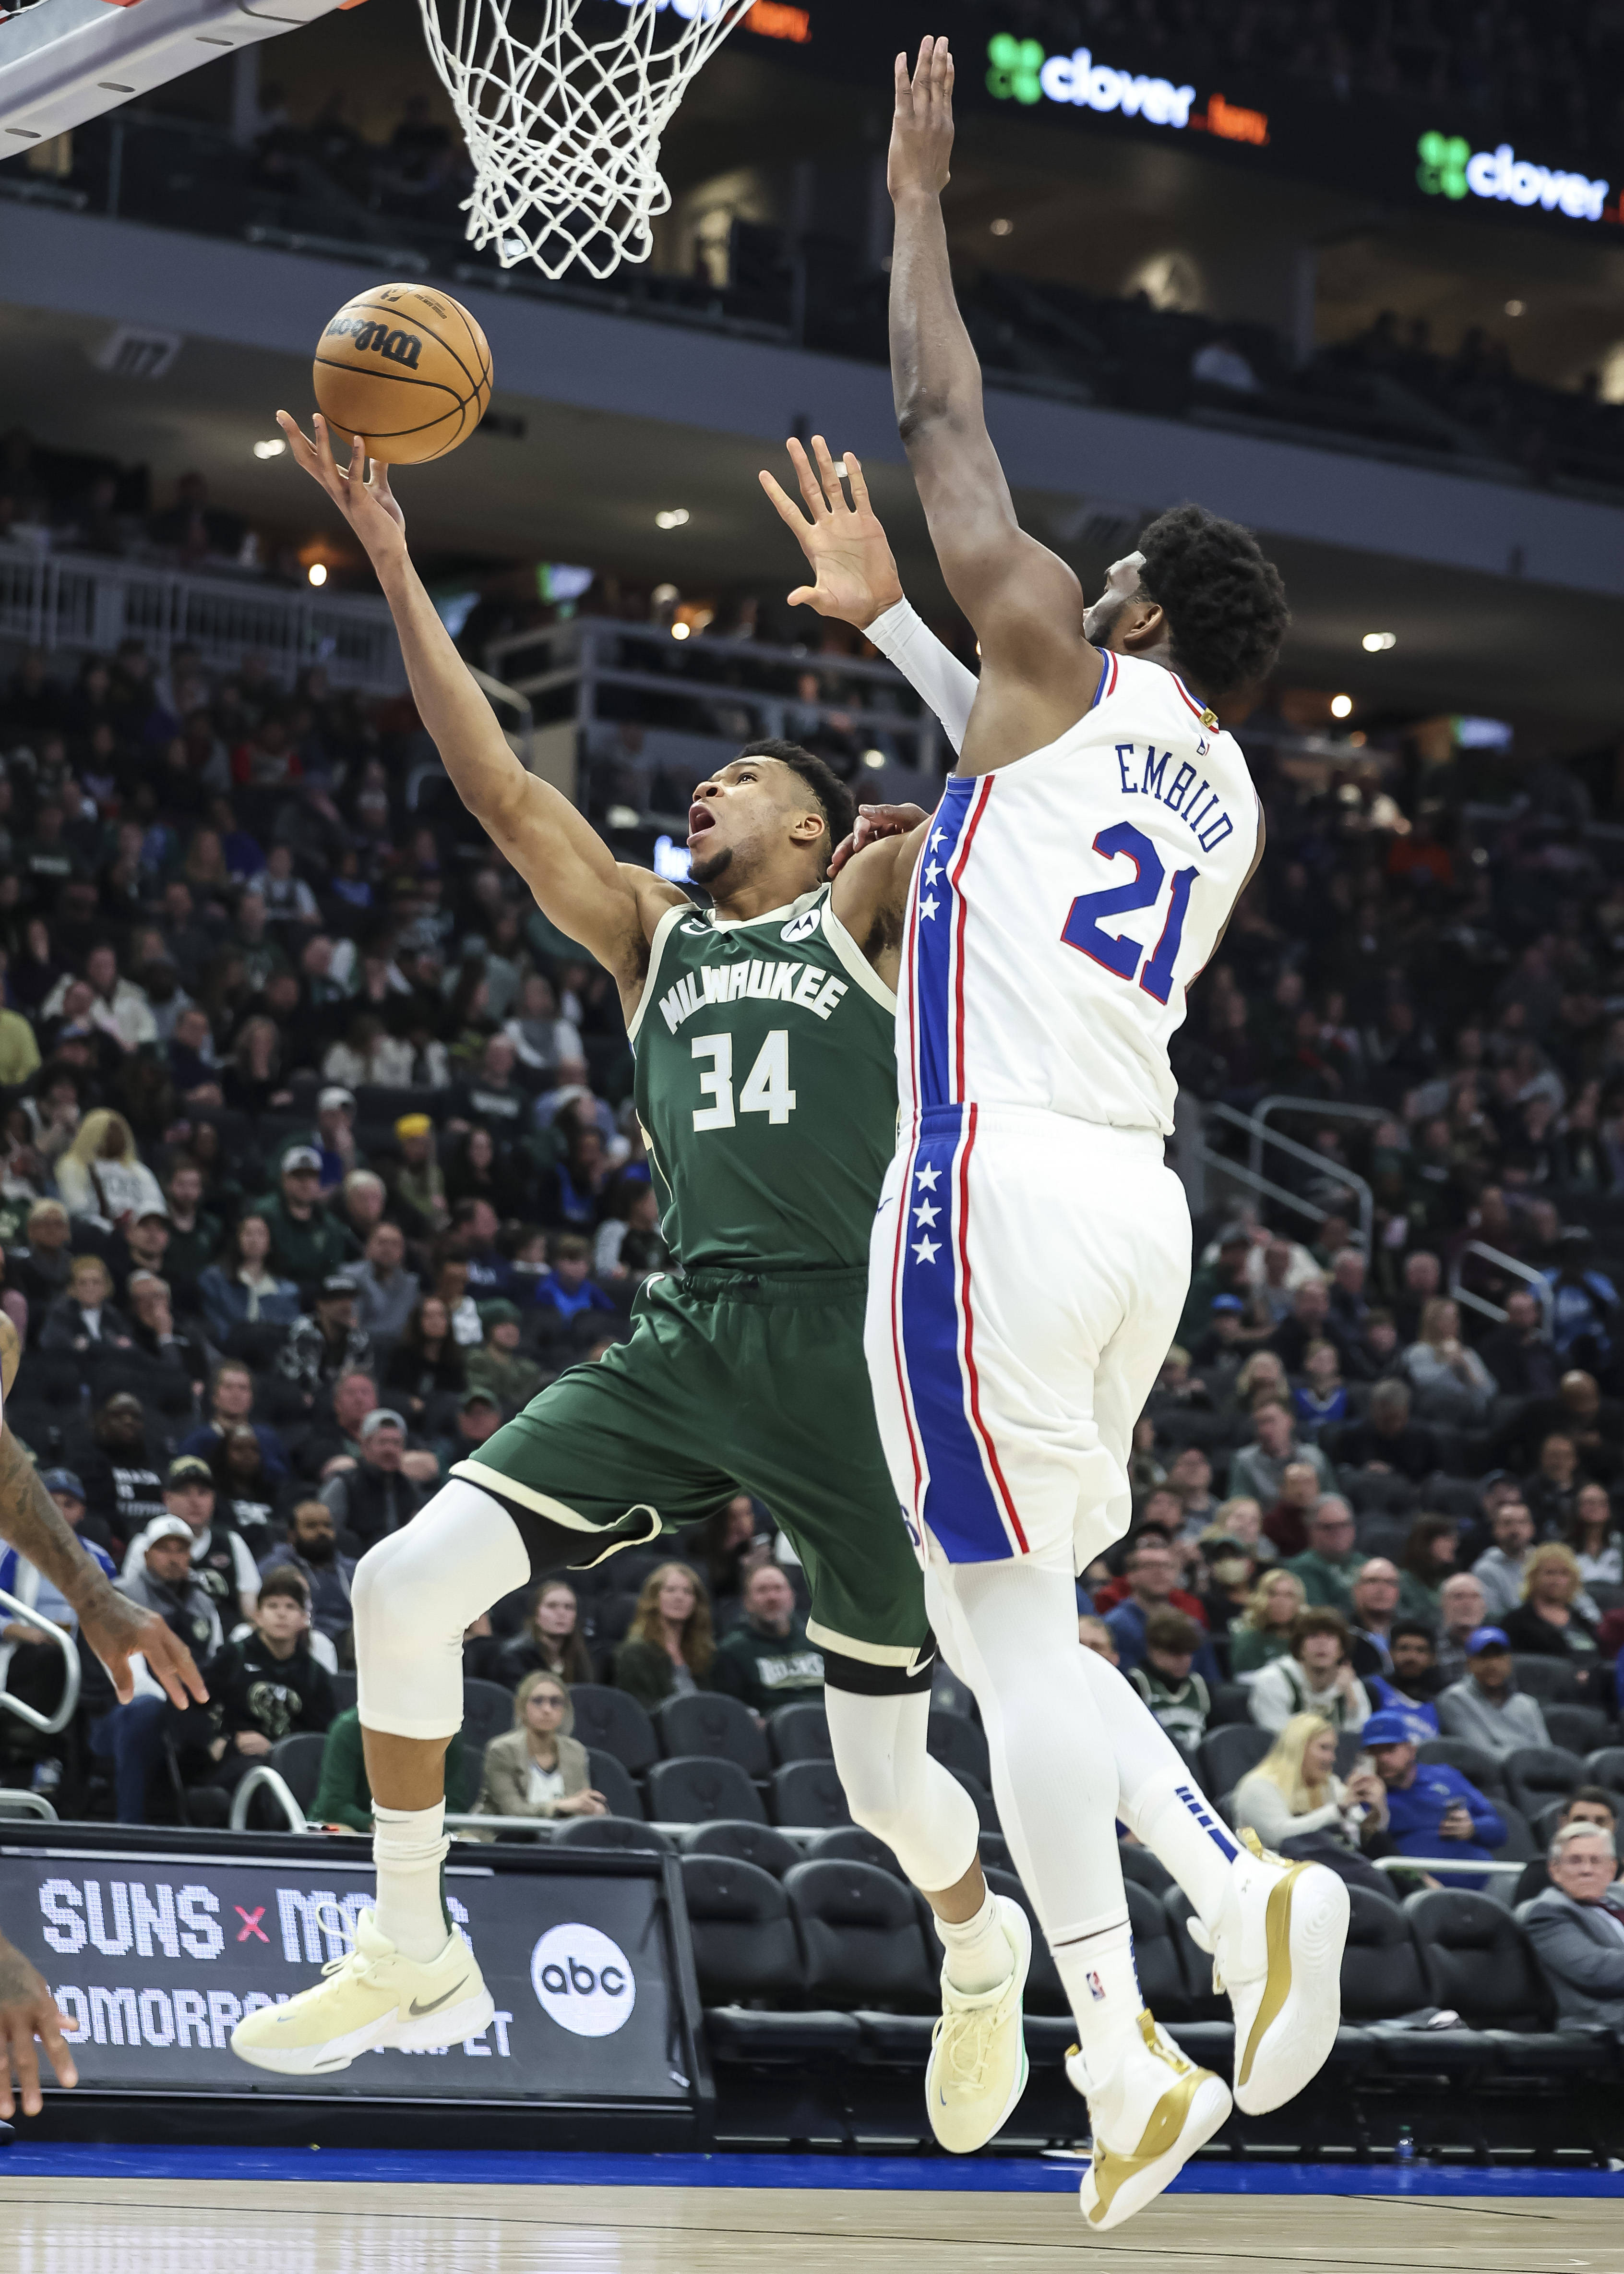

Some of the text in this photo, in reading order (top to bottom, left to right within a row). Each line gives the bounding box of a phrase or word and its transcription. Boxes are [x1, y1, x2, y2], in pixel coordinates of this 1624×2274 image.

[1040, 47, 1196, 128] clover
[1465, 144, 1609, 221] clover
[1115, 744, 1233, 853] EMBIID
[1060, 821, 1200, 1006] 21
[658, 959, 849, 1035] MILWAUKEE
[691, 1029, 797, 1132] 34
[38, 1878, 226, 1960] SUNS
[541, 1957, 623, 1996] abc
